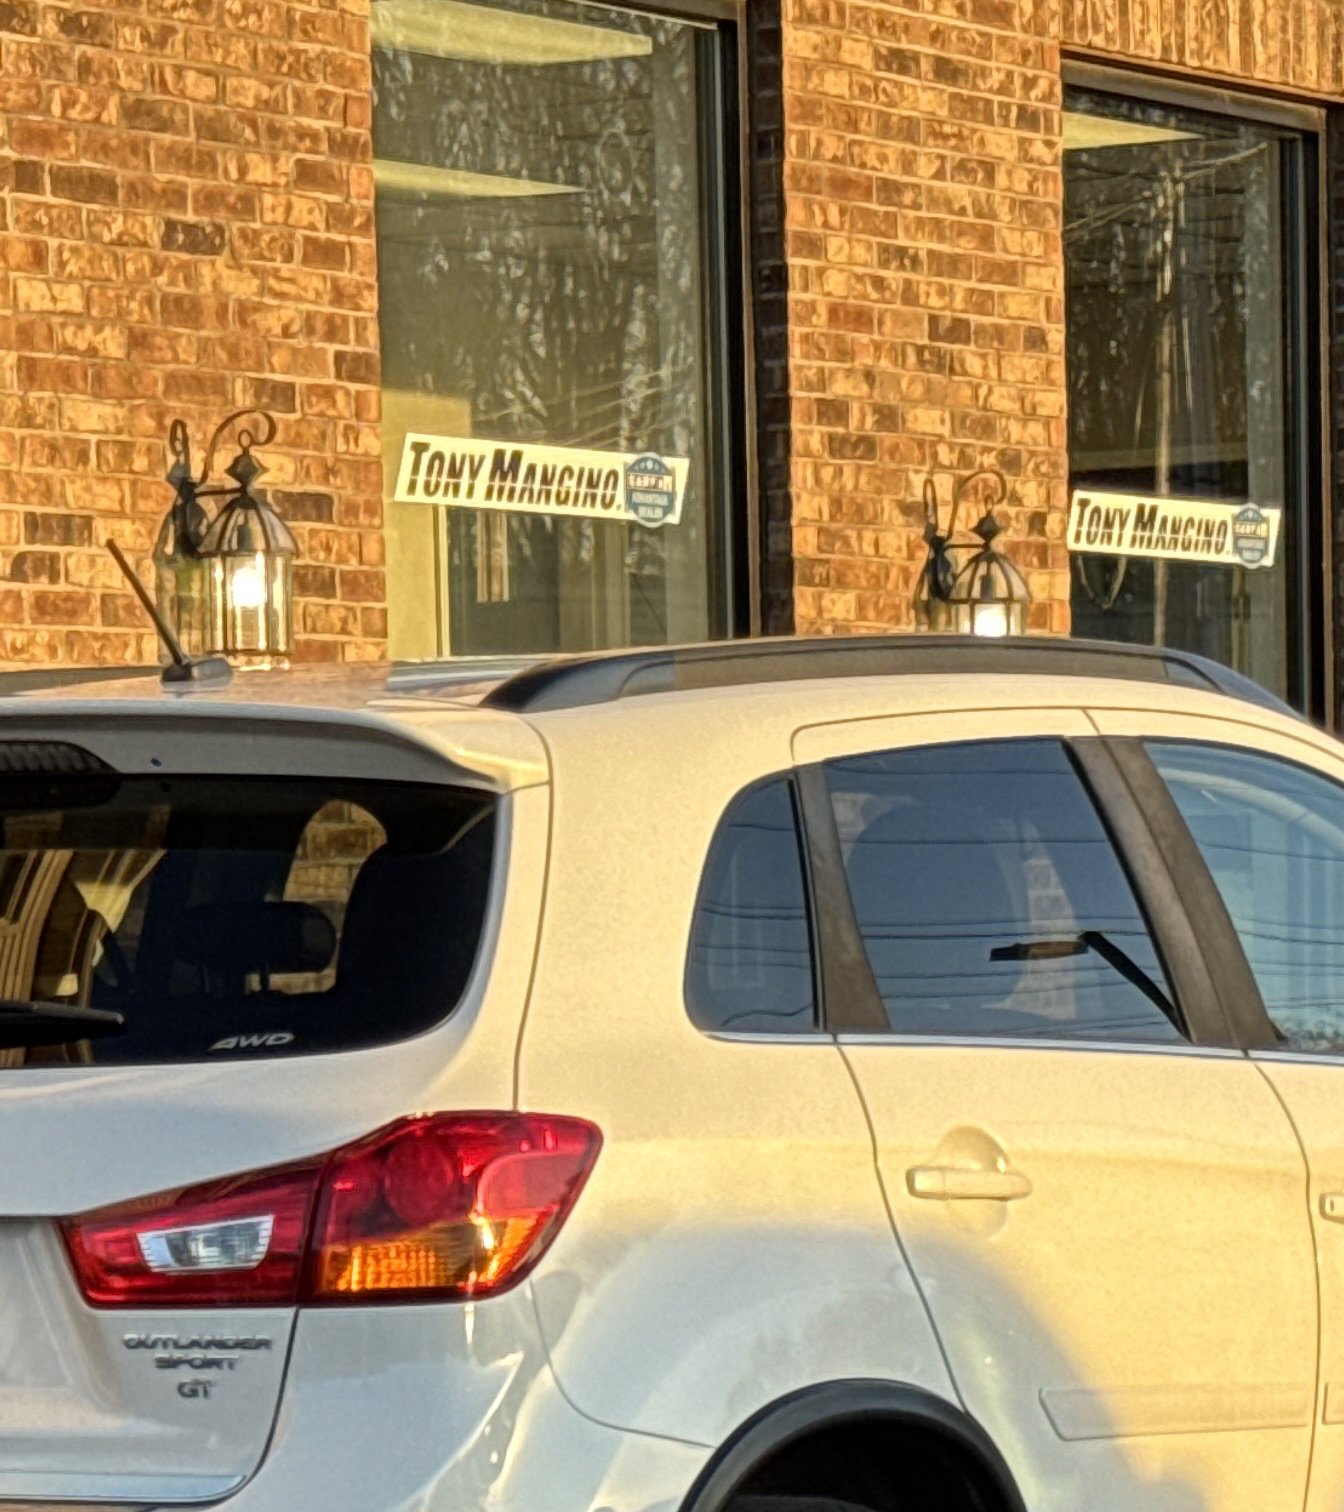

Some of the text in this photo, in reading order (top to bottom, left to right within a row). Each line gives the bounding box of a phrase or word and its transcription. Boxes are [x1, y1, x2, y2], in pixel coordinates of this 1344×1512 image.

[406, 441, 486, 500] TONY
[1073, 498, 1131, 547] TONY
[207, 1032, 295, 1051] AWD
[123, 1334, 273, 1350] OUTLANDER
[154, 1353, 240, 1370] SPORT
[177, 1378, 216, 1398] GT
